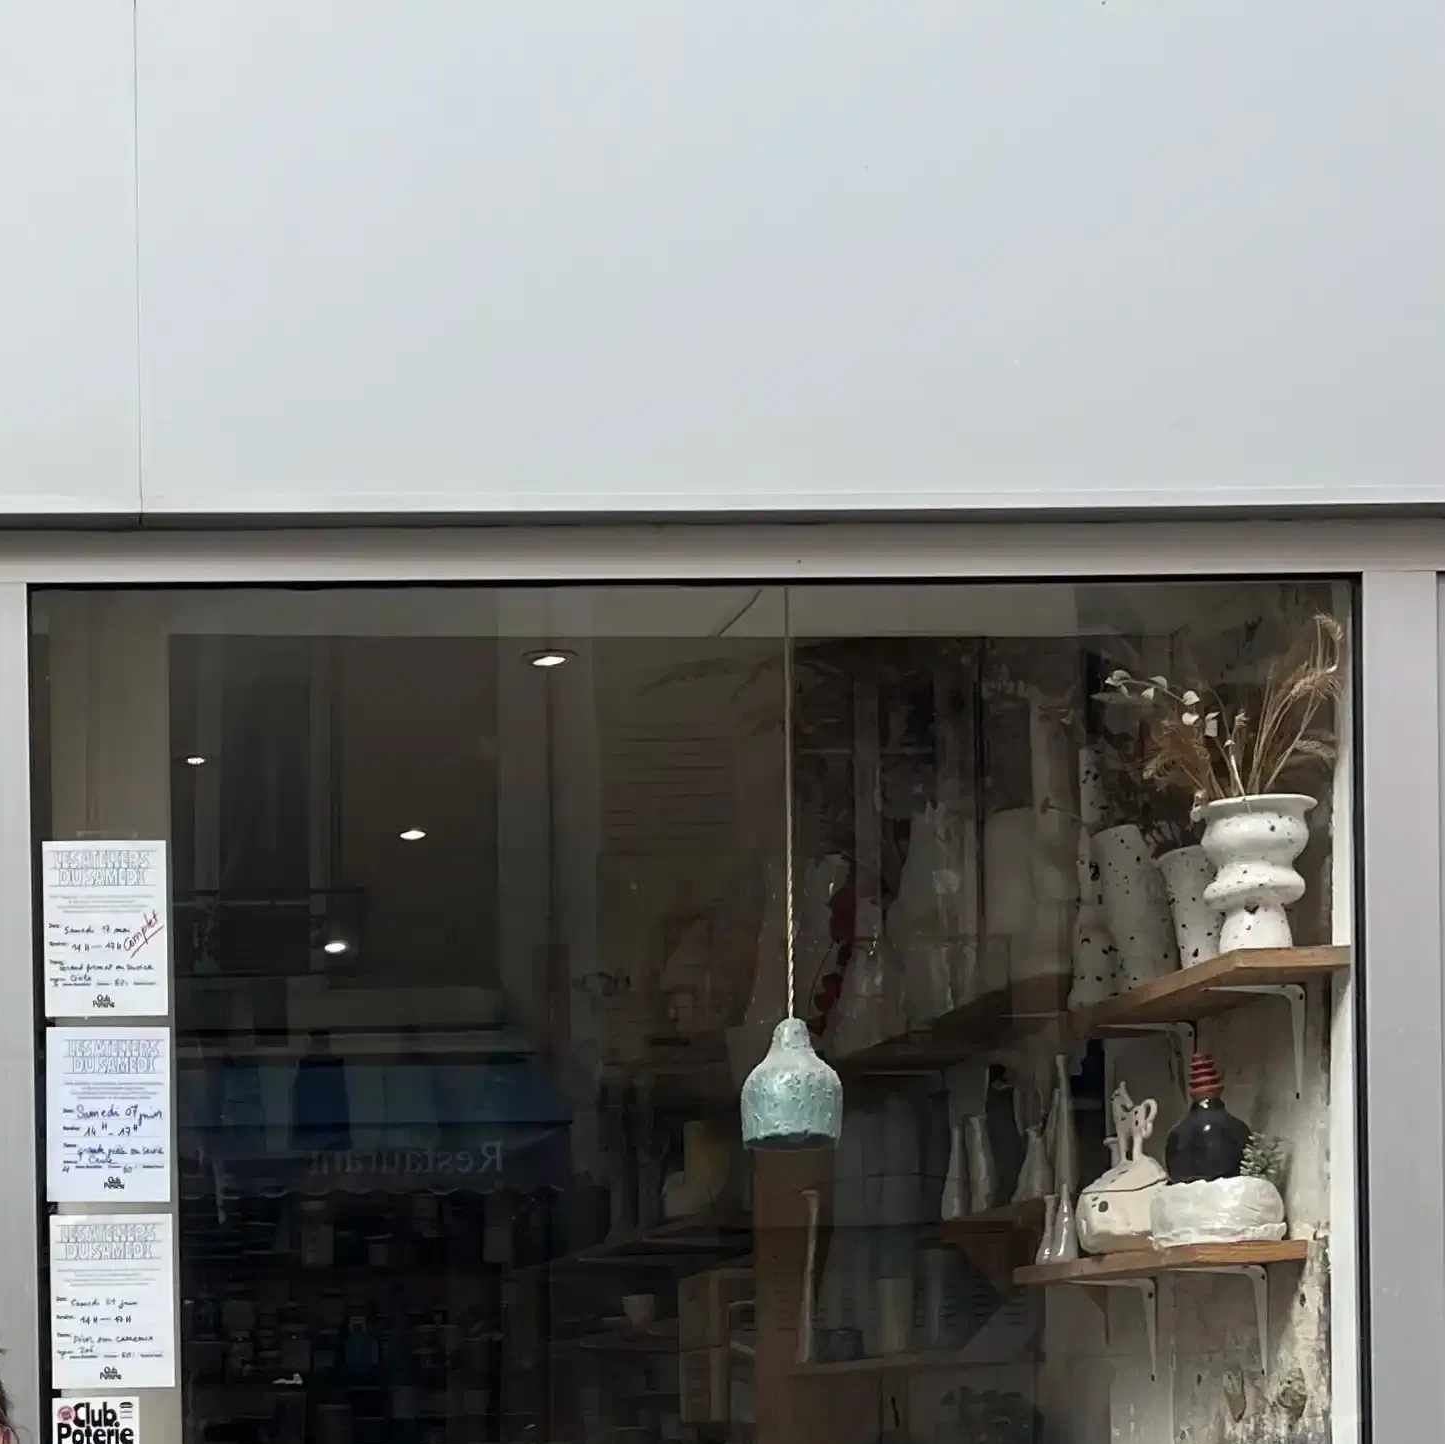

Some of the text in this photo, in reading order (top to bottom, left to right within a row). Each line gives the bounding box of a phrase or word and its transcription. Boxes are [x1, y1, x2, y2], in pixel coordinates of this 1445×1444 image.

[72, 1056, 156, 1074] DU SAMEDI
[76, 1104, 120, 1120] Samedi
[73, 1401, 117, 1427] Club
